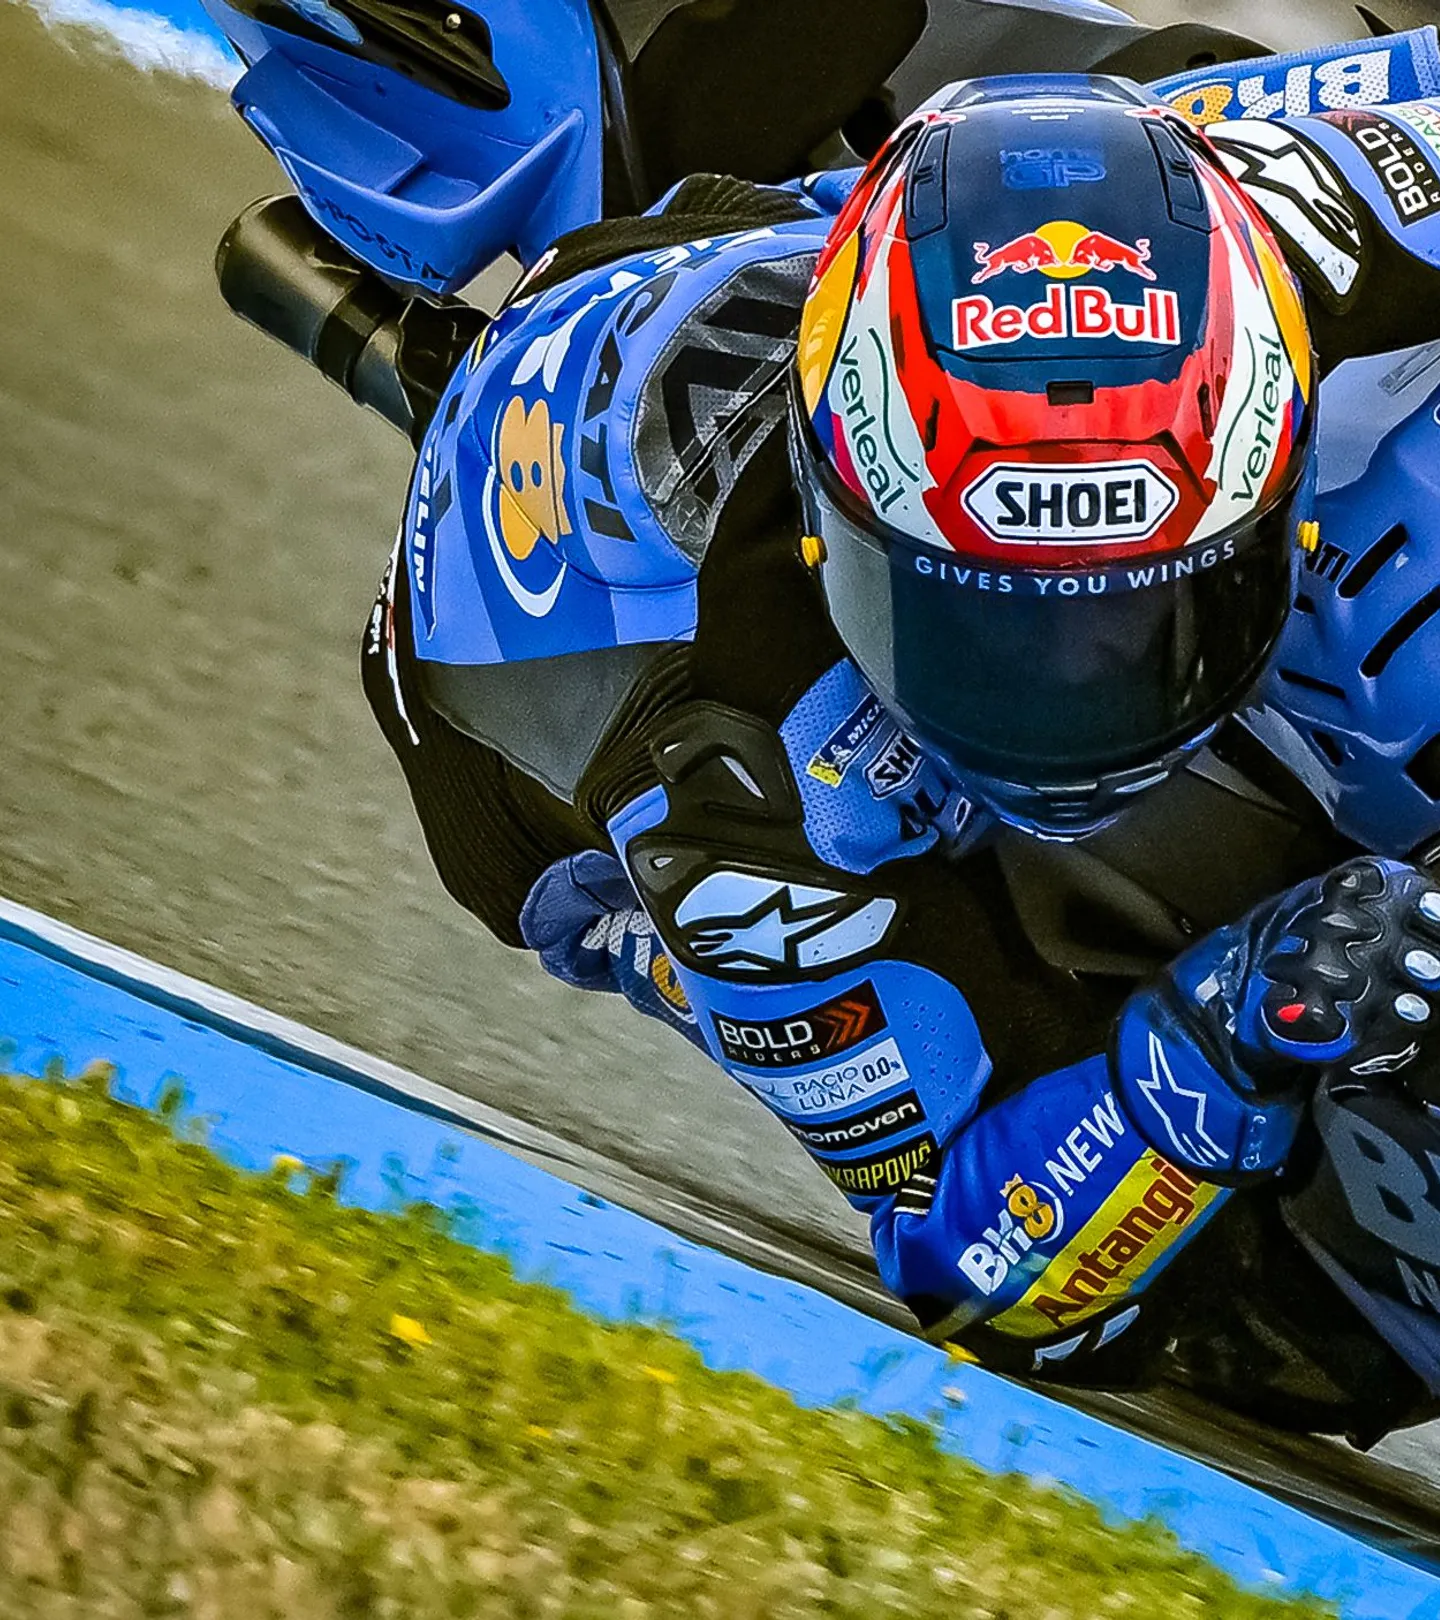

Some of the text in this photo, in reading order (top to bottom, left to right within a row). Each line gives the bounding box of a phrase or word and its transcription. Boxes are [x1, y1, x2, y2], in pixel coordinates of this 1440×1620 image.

[1356, 127, 1429, 217] BOLD
[951, 284, 1182, 349] Red Bull
[840, 335, 910, 515] verleal
[1231, 334, 1280, 505] verleal
[995, 478, 1147, 529] SHOEI
[915, 539, 1237, 597] GIVES YOU WINGS
[719, 1020, 814, 1050] BOLD
[727, 1043, 821, 1062] RIDERS
[957, 1182, 1055, 1297] BK8
